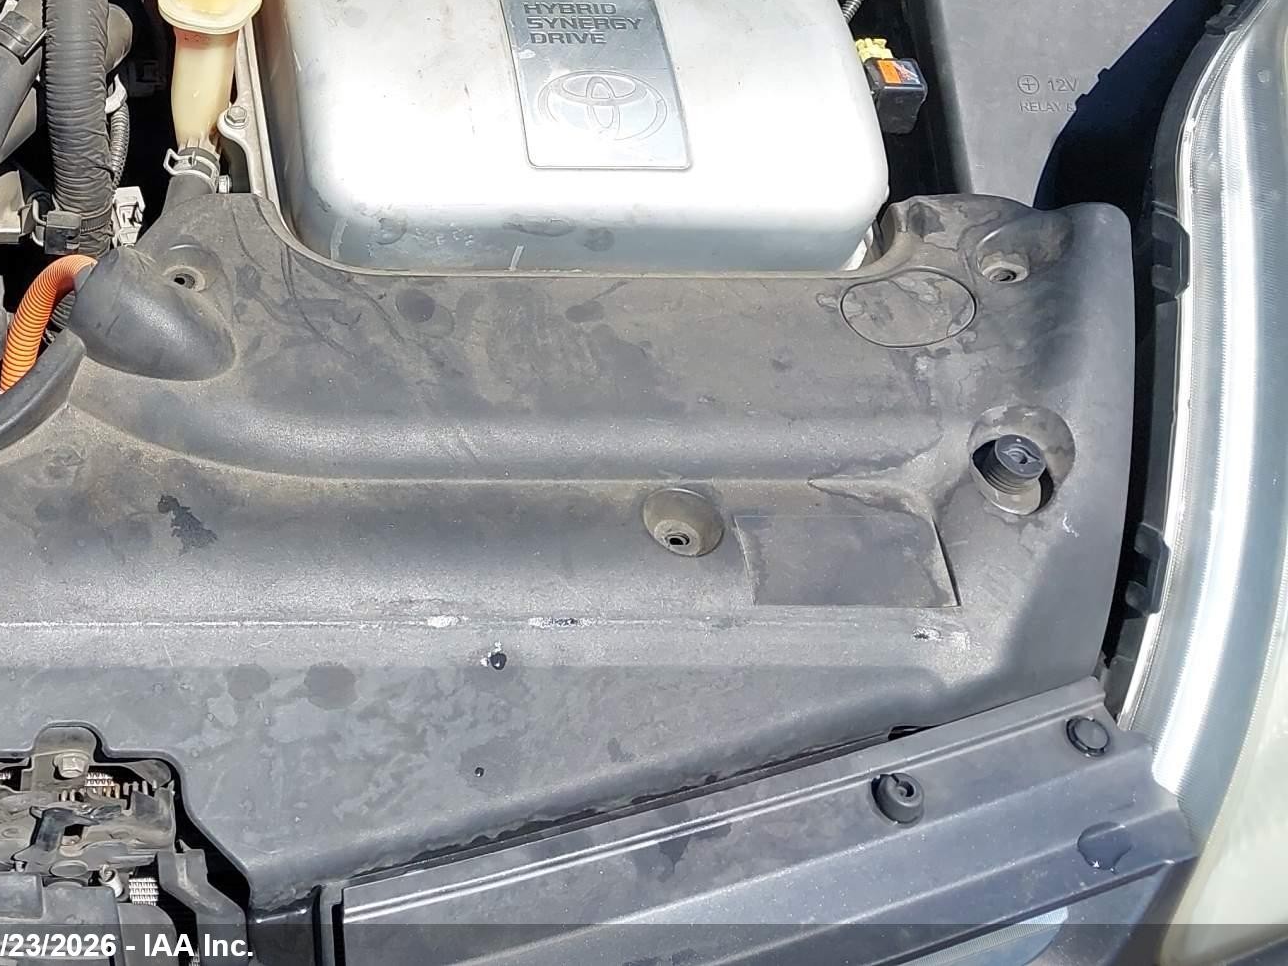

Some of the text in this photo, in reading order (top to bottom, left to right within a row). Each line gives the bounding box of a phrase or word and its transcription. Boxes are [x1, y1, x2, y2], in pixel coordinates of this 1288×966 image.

[523, 1, 617, 15] HYBRID
[527, 17, 643, 30] SYNERGY
[530, 31, 607, 45] DRIVE
[1047, 77, 1078, 92] 12V
